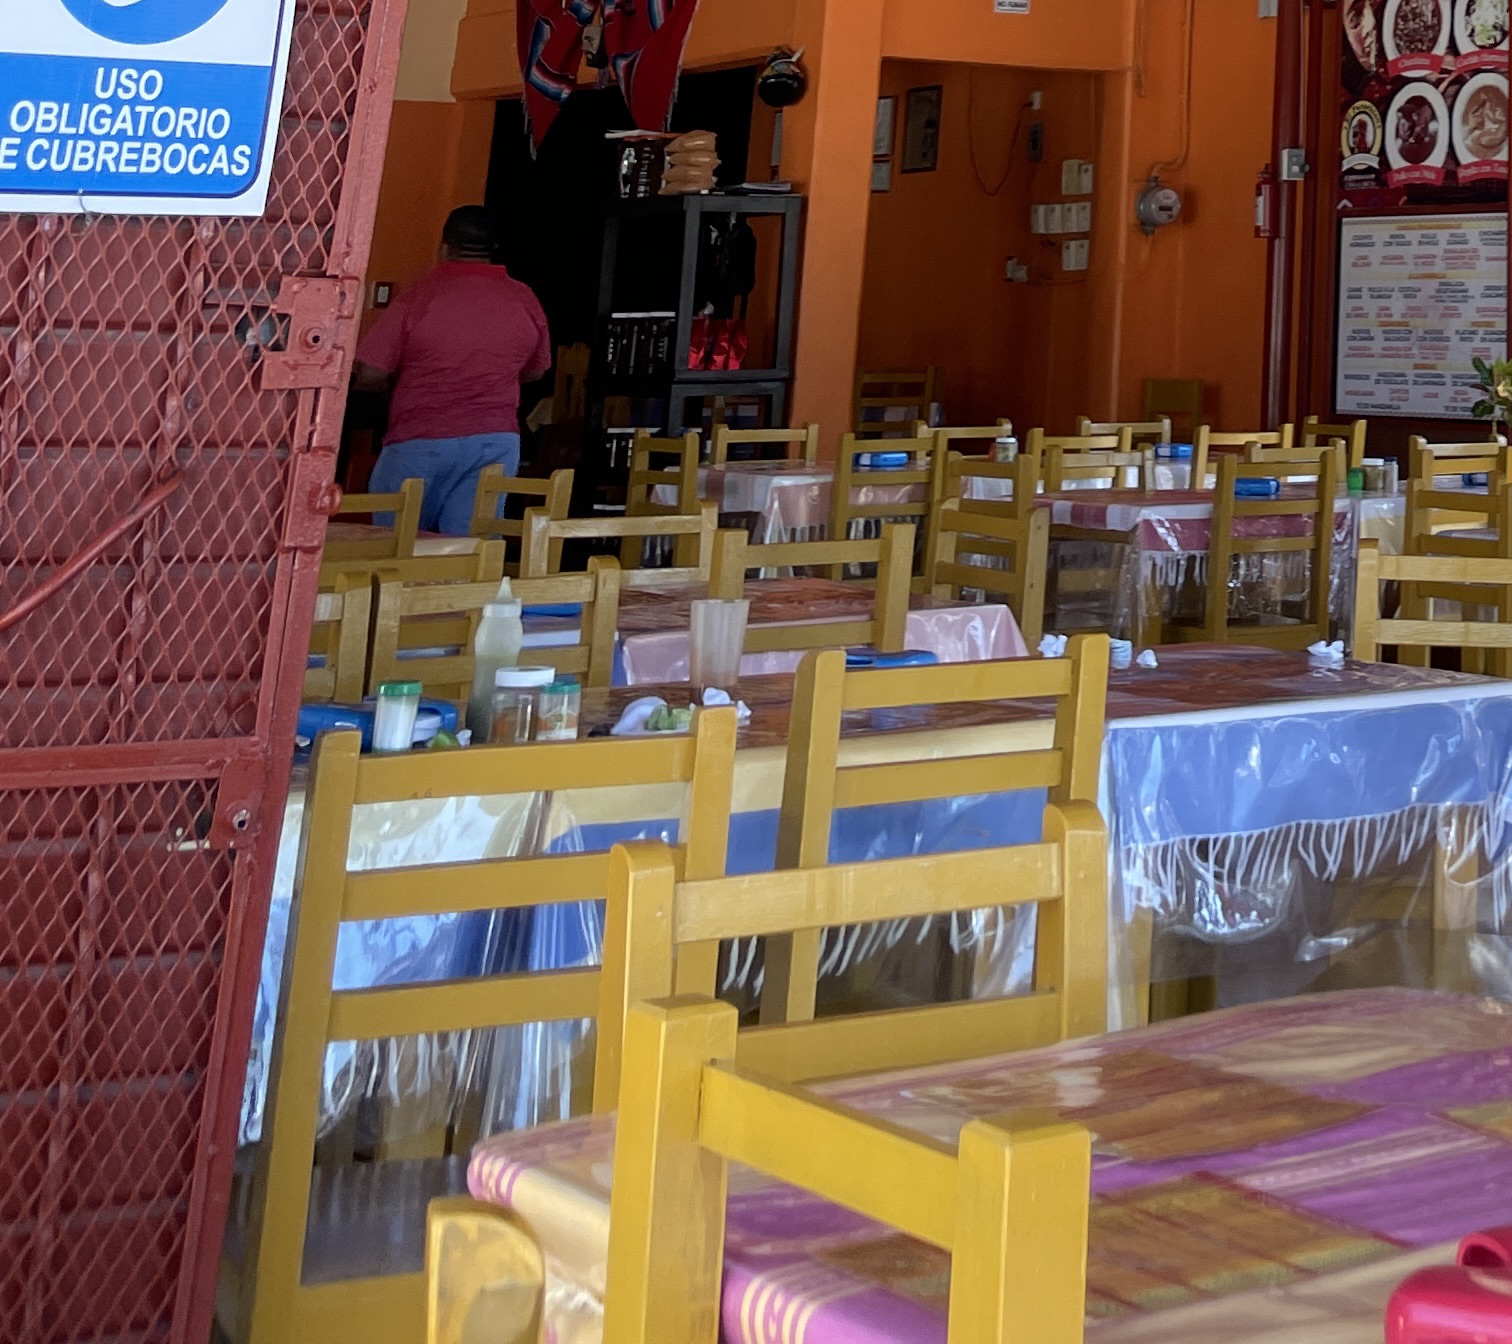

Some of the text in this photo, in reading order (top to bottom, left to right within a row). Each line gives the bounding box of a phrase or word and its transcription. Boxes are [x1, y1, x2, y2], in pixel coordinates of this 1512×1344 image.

[94, 67, 163, 100] USO
[10, 100, 231, 140] OBLIGATORIO
[26, 138, 251, 176] CUBREBOCAS
